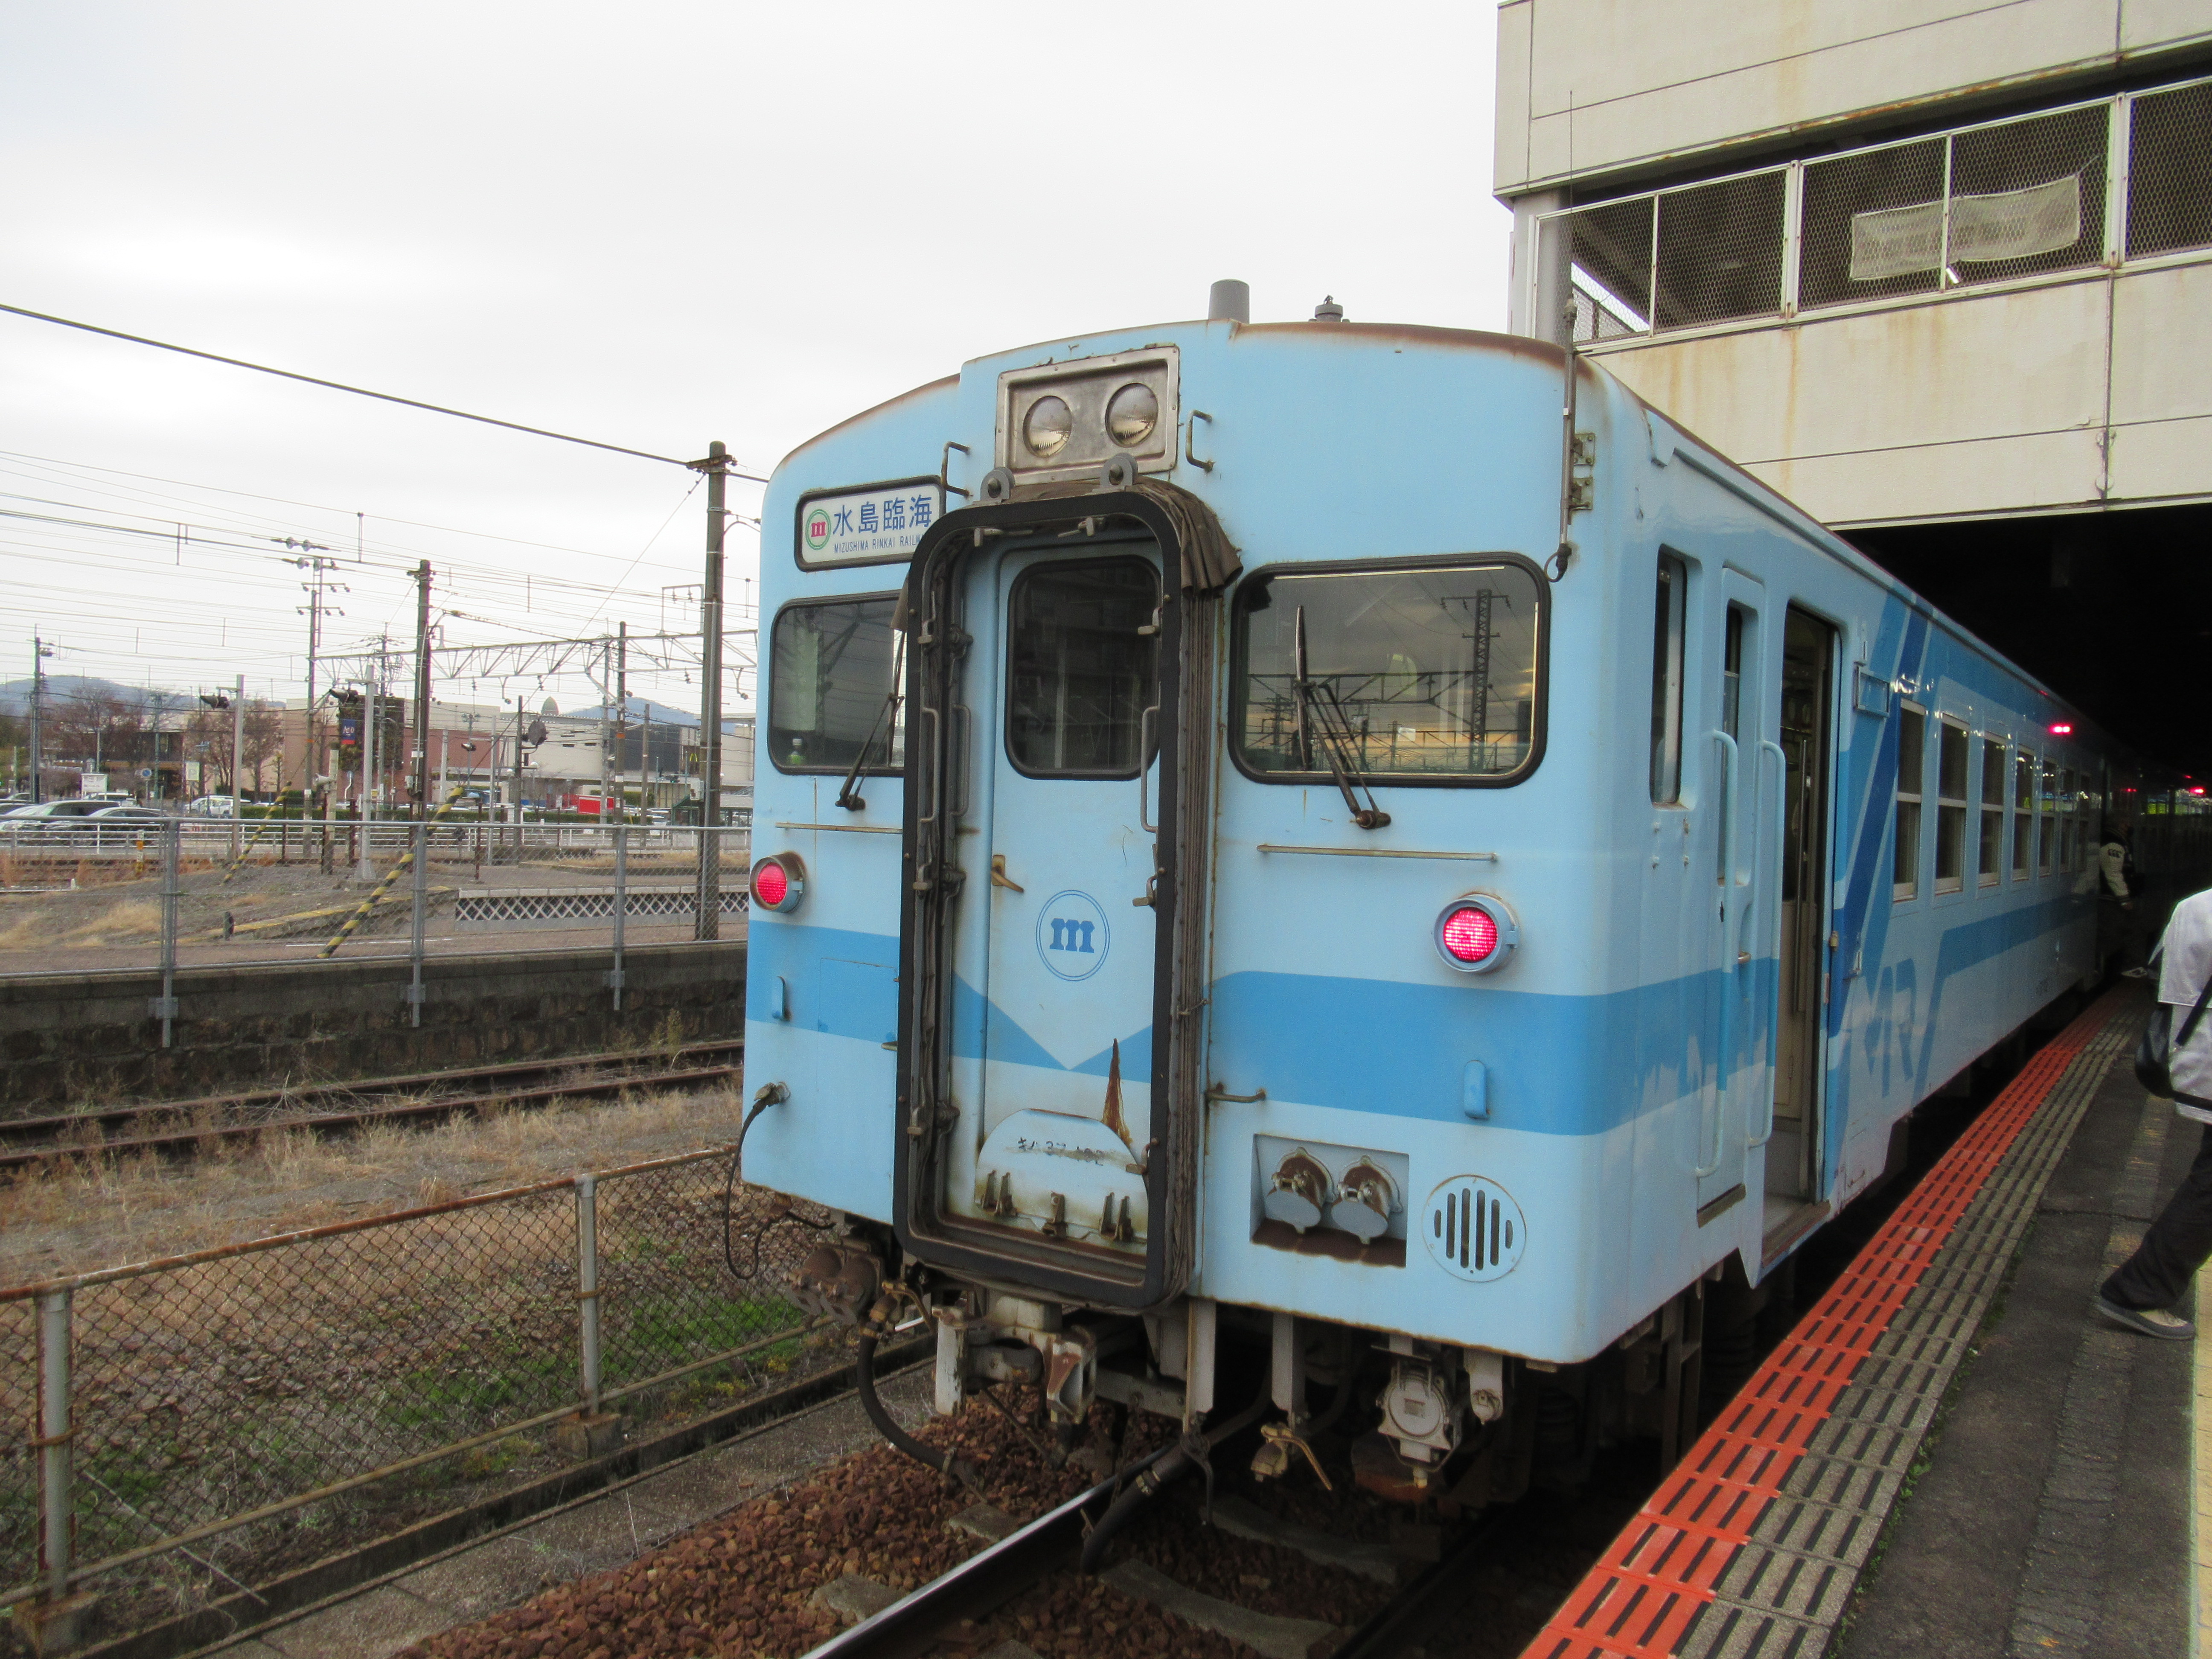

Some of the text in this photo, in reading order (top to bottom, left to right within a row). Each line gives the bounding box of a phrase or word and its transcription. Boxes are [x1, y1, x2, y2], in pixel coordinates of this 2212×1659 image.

[832, 494, 932, 537] 水島臨海
[834, 534, 923, 553] MIZUSHIMA RINKAI RAILW
